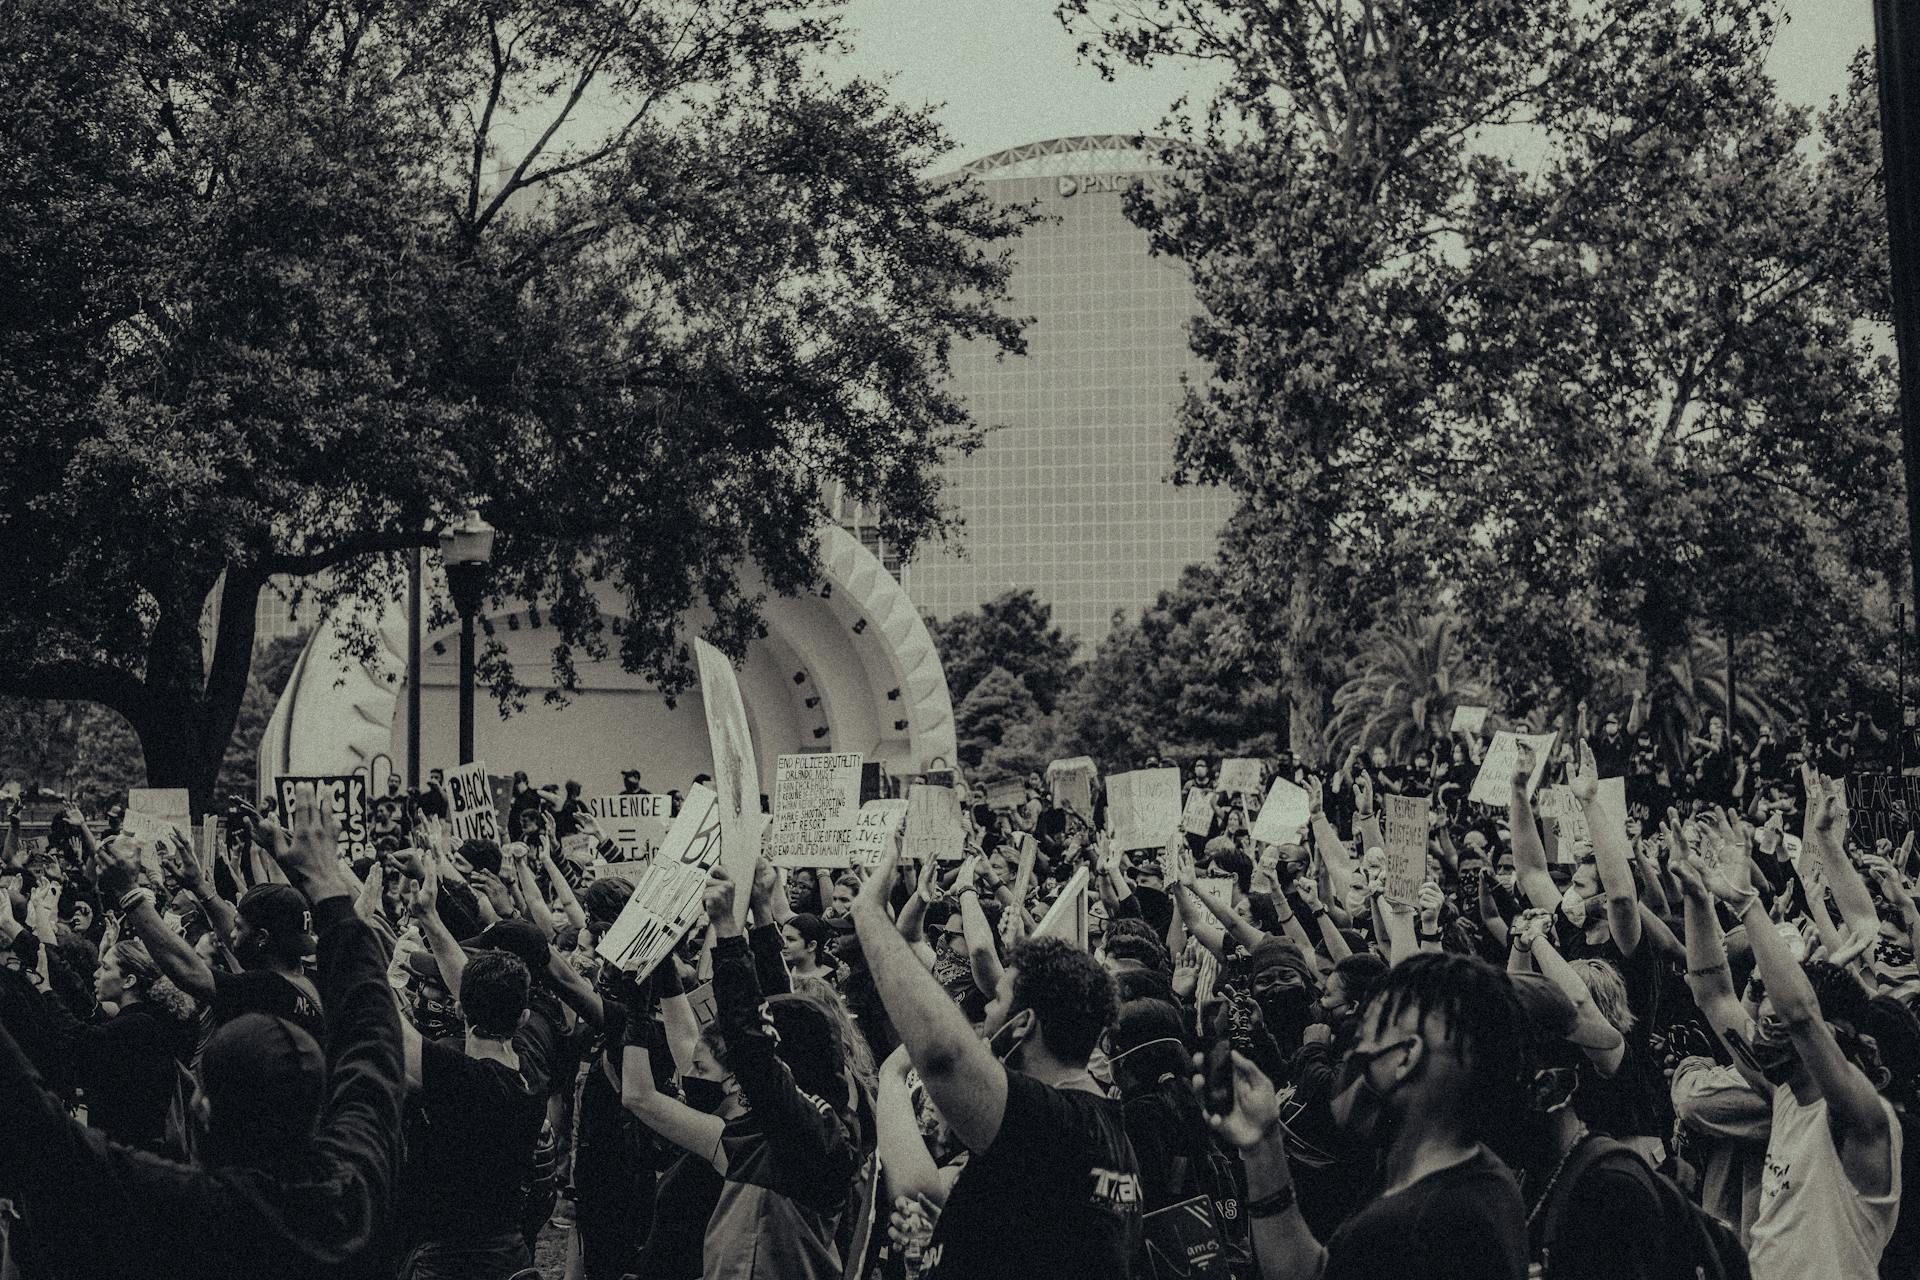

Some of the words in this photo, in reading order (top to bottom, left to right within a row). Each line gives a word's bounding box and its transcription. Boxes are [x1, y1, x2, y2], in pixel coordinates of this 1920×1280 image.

[779, 757, 795, 769] END
[282, 779, 364, 816] BCK
[1844, 773, 1870, 809] WE
[1870, 775, 1897, 811] ARE
[591, 797, 662, 818] SILENCE
[800, 818, 827, 831] RESORT
[857, 811, 889, 826] LACK
[856, 829, 886, 843] IVES
